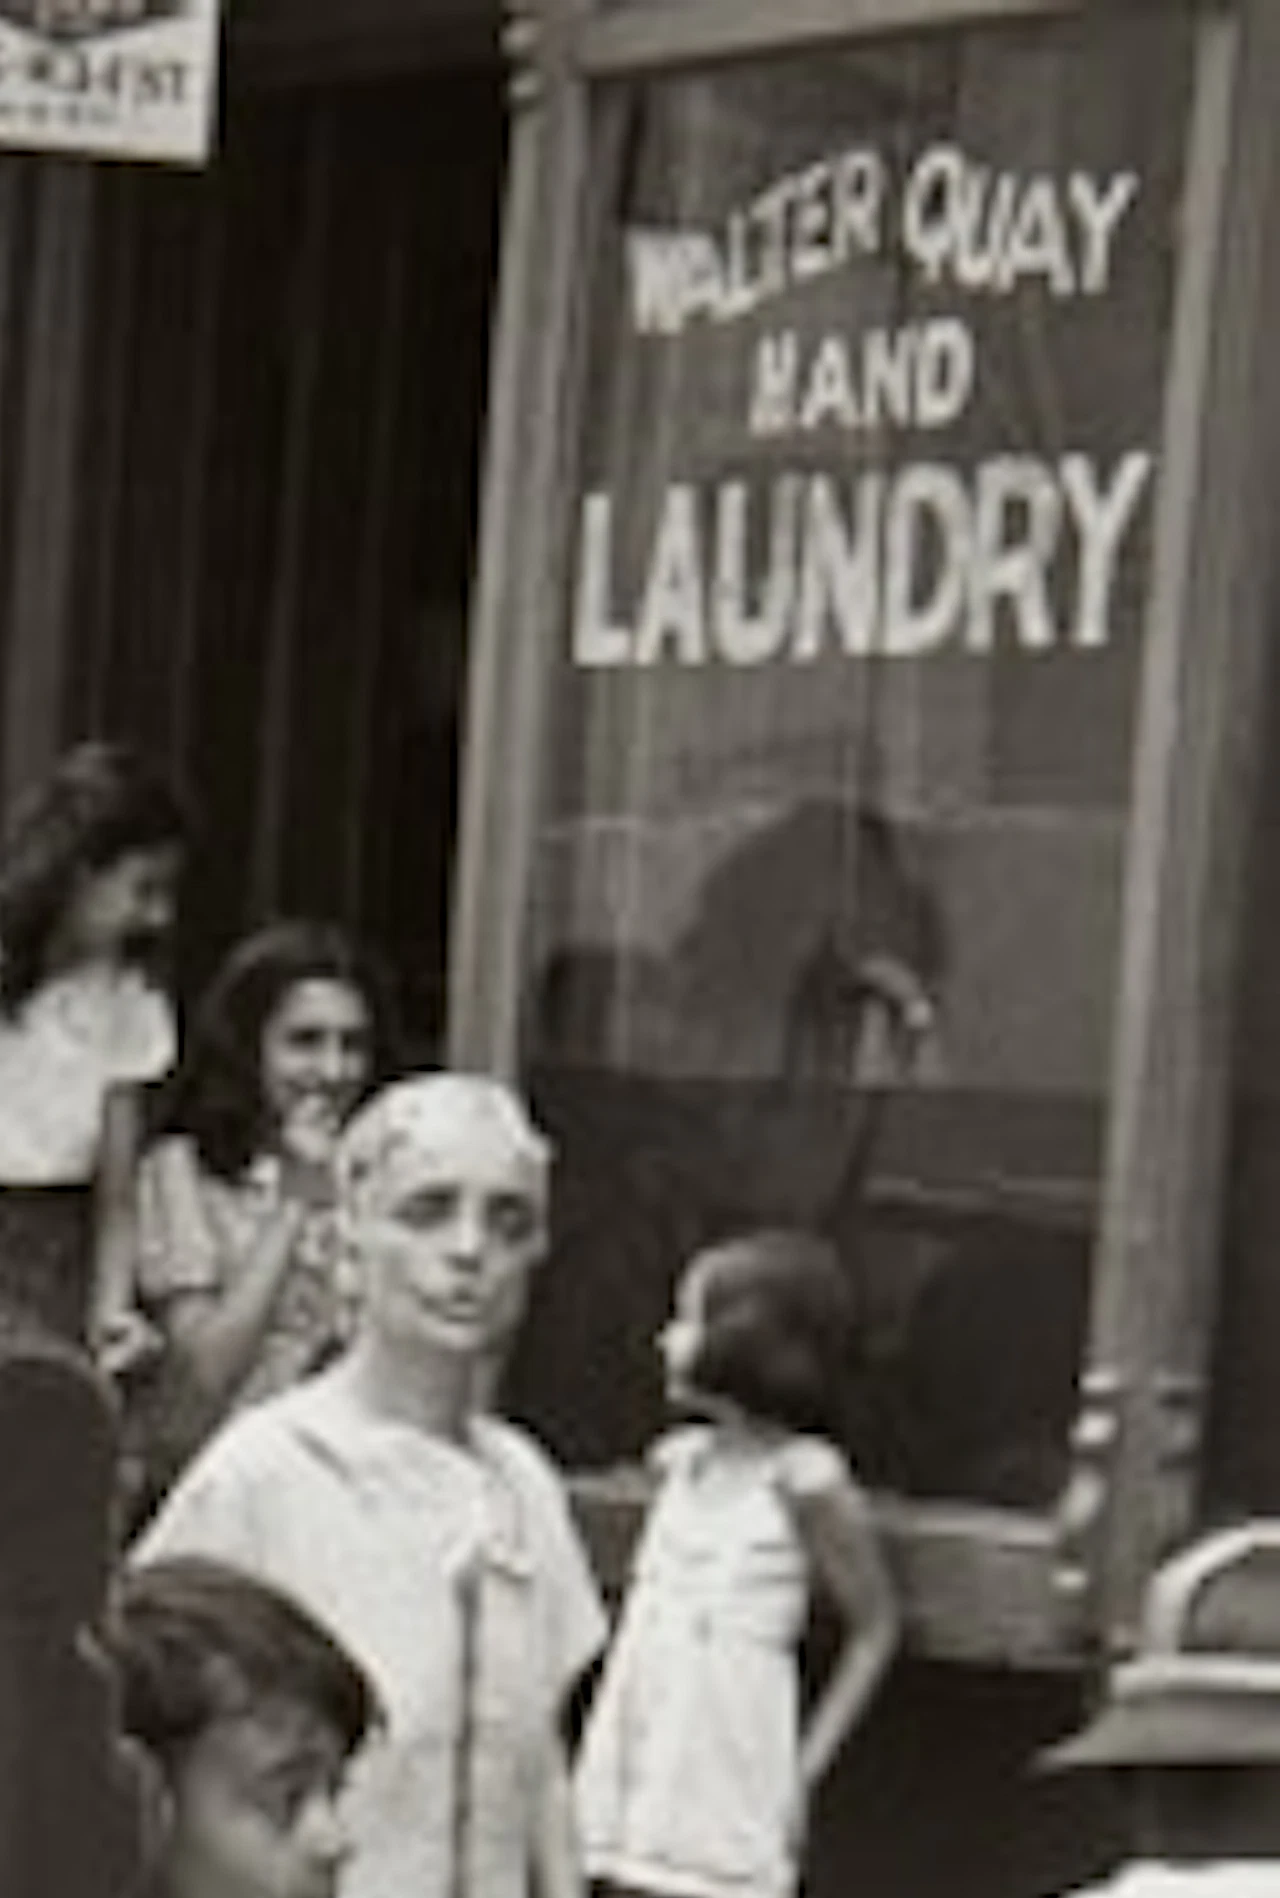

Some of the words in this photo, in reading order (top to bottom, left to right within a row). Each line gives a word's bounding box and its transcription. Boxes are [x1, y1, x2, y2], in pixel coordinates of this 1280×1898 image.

[626, 148, 886, 334] WALTER
[904, 142, 1139, 296] QUAY
[749, 316, 974, 438] HAND
[572, 451, 1152, 667] LAUNDRY
